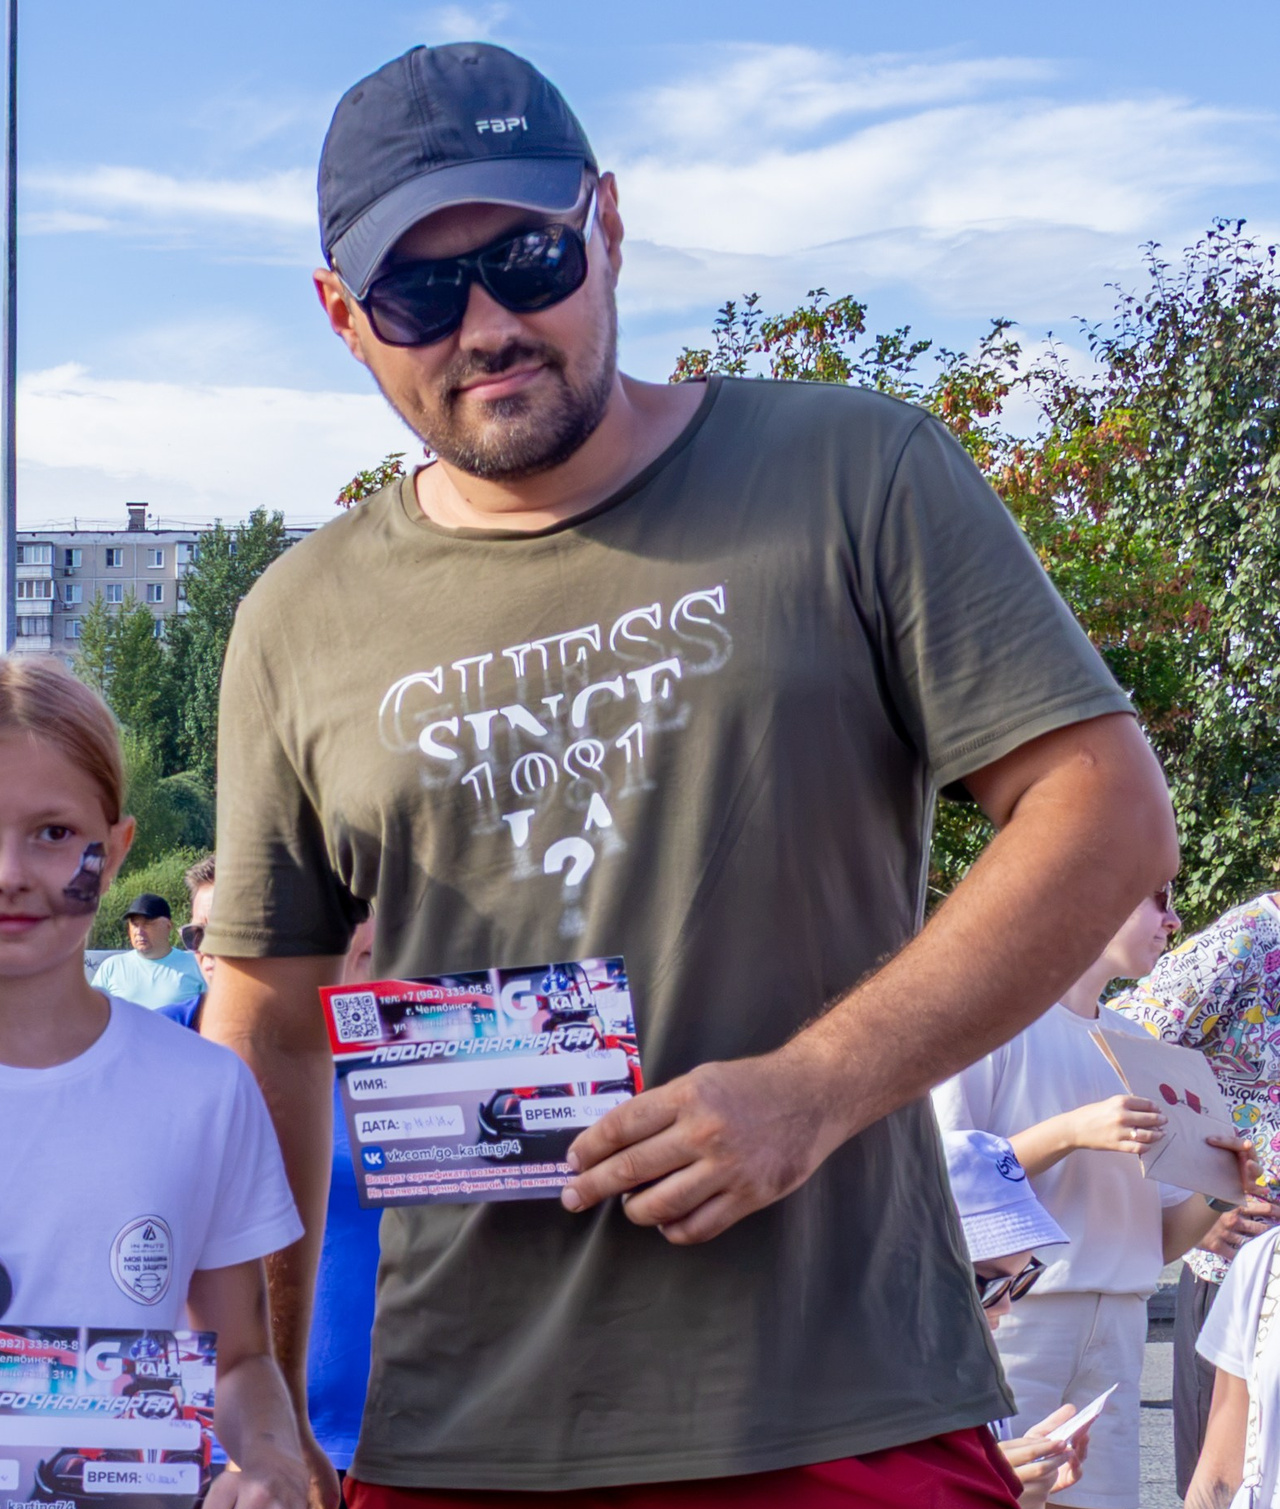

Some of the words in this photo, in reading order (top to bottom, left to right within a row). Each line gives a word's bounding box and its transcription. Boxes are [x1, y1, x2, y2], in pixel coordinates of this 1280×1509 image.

[416, 989, 444, 1001] (982)
[353, 1079, 388, 1092] ИМЯ:
[525, 1106, 576, 1121] ВРЕМЯ:
[361, 1119, 400, 1133] ДАТА:
[387, 1140, 521, 1163] vk.com/go_karting74
[87, 1470, 142, 1484] ВРЕМЯ:
